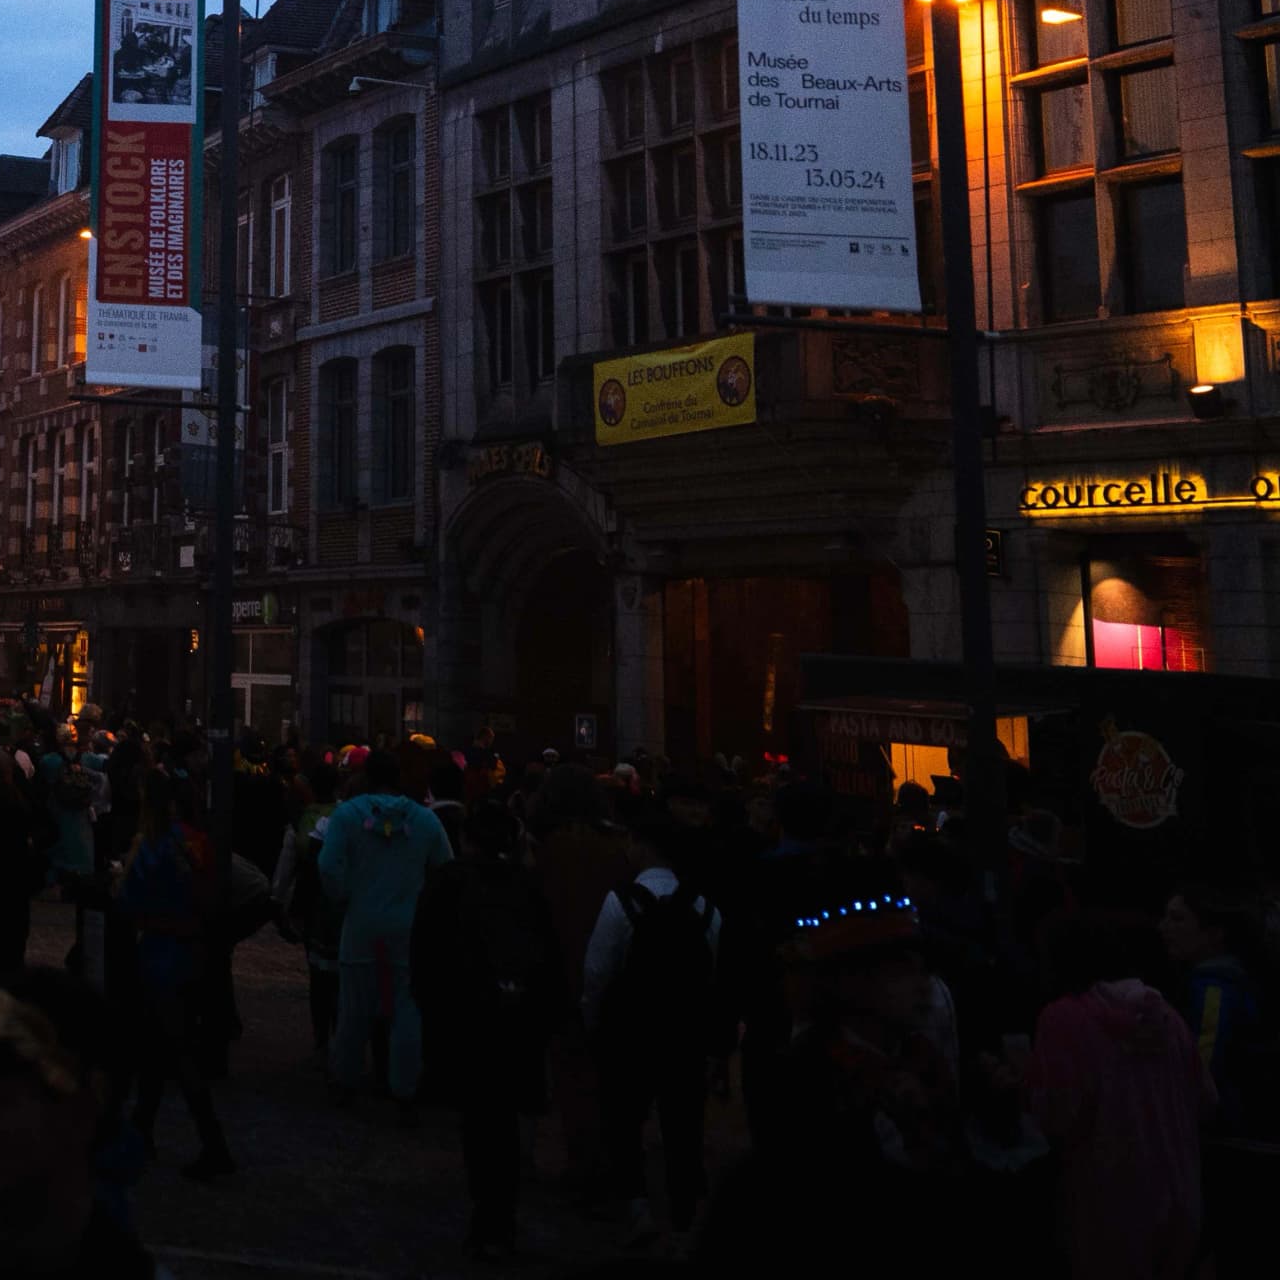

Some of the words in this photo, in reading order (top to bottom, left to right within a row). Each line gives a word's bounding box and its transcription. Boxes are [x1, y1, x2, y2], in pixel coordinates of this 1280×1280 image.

[799, 6, 822, 25] du
[827, 9, 881, 29] temps
[747, 51, 809, 70] Musée
[747, 72, 779, 88] des
[801, 73, 902, 93] Beaux-Arts
[748, 91, 771, 107] de
[775, 93, 840, 110] Tournai
[749, 142, 819, 162] 18.11.23
[805, 168, 886, 189] 13.05.24
[150, 158, 167, 231] FOLKLORE
[168, 158, 185, 251] IMAGINAIRES
[149, 232, 166, 249] DE
[145, 251, 166, 298] MUSÉE
[167, 252, 184, 281] DES
[167, 283, 184, 299] ET
[628, 368, 644, 387] LES
[646, 355, 715, 383] BOUFFONS
[1020, 472, 1197, 508] courcelle
[829, 712, 880, 737] PASTA
[888, 718, 923, 741] AND
